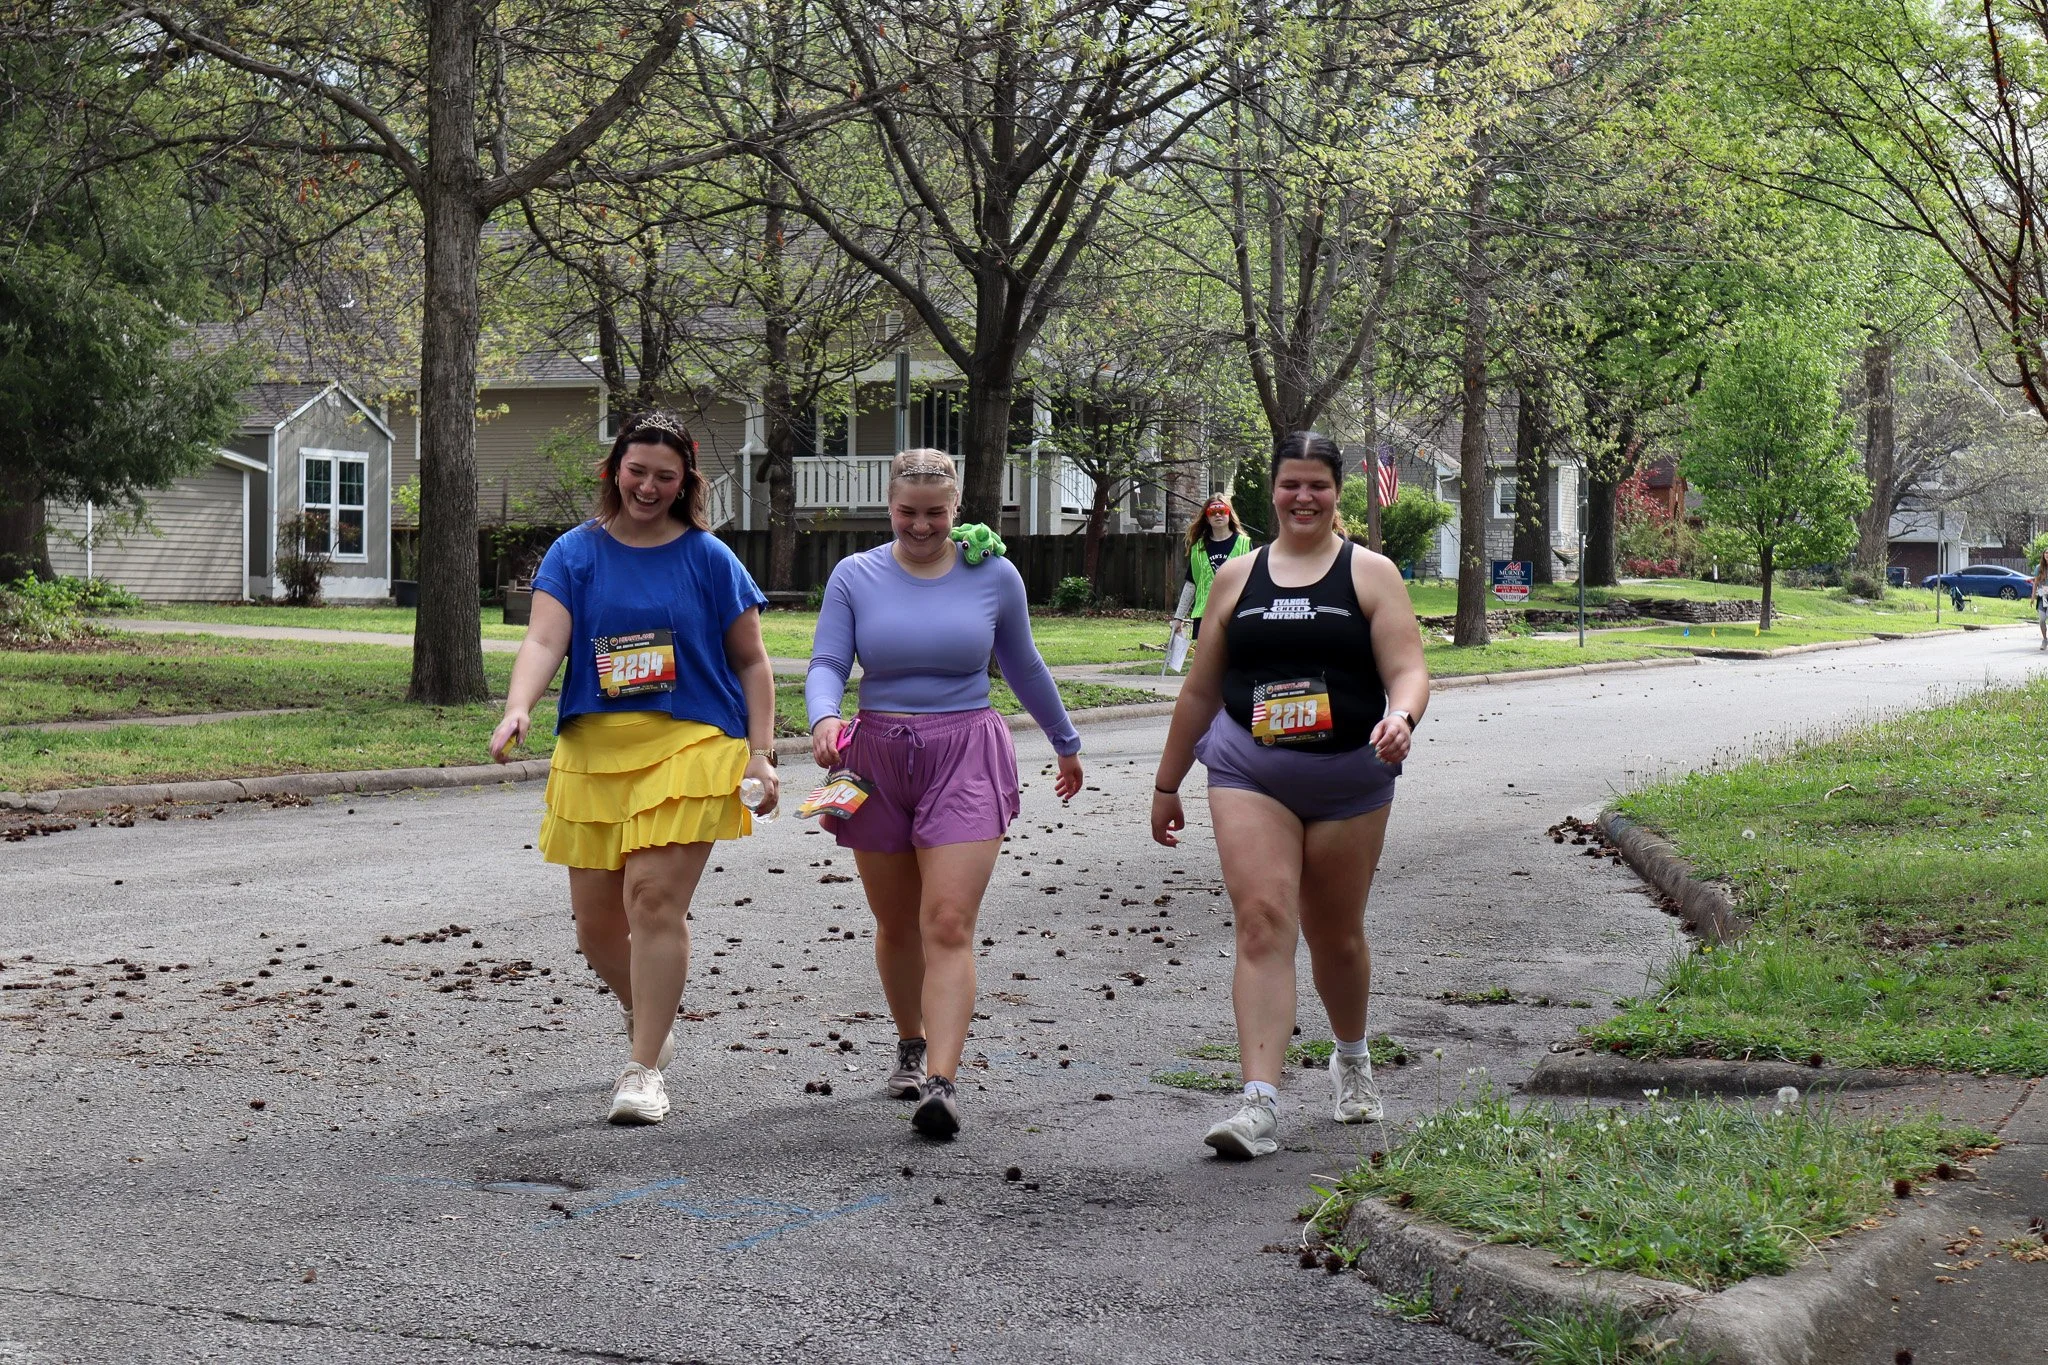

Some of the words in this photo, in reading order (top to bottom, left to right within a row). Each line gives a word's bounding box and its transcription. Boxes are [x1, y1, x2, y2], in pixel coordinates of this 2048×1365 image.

[1273, 598, 1310, 606] EVANGEL
[612, 651, 664, 683] 2294
[1269, 699, 1318, 731] 2213
